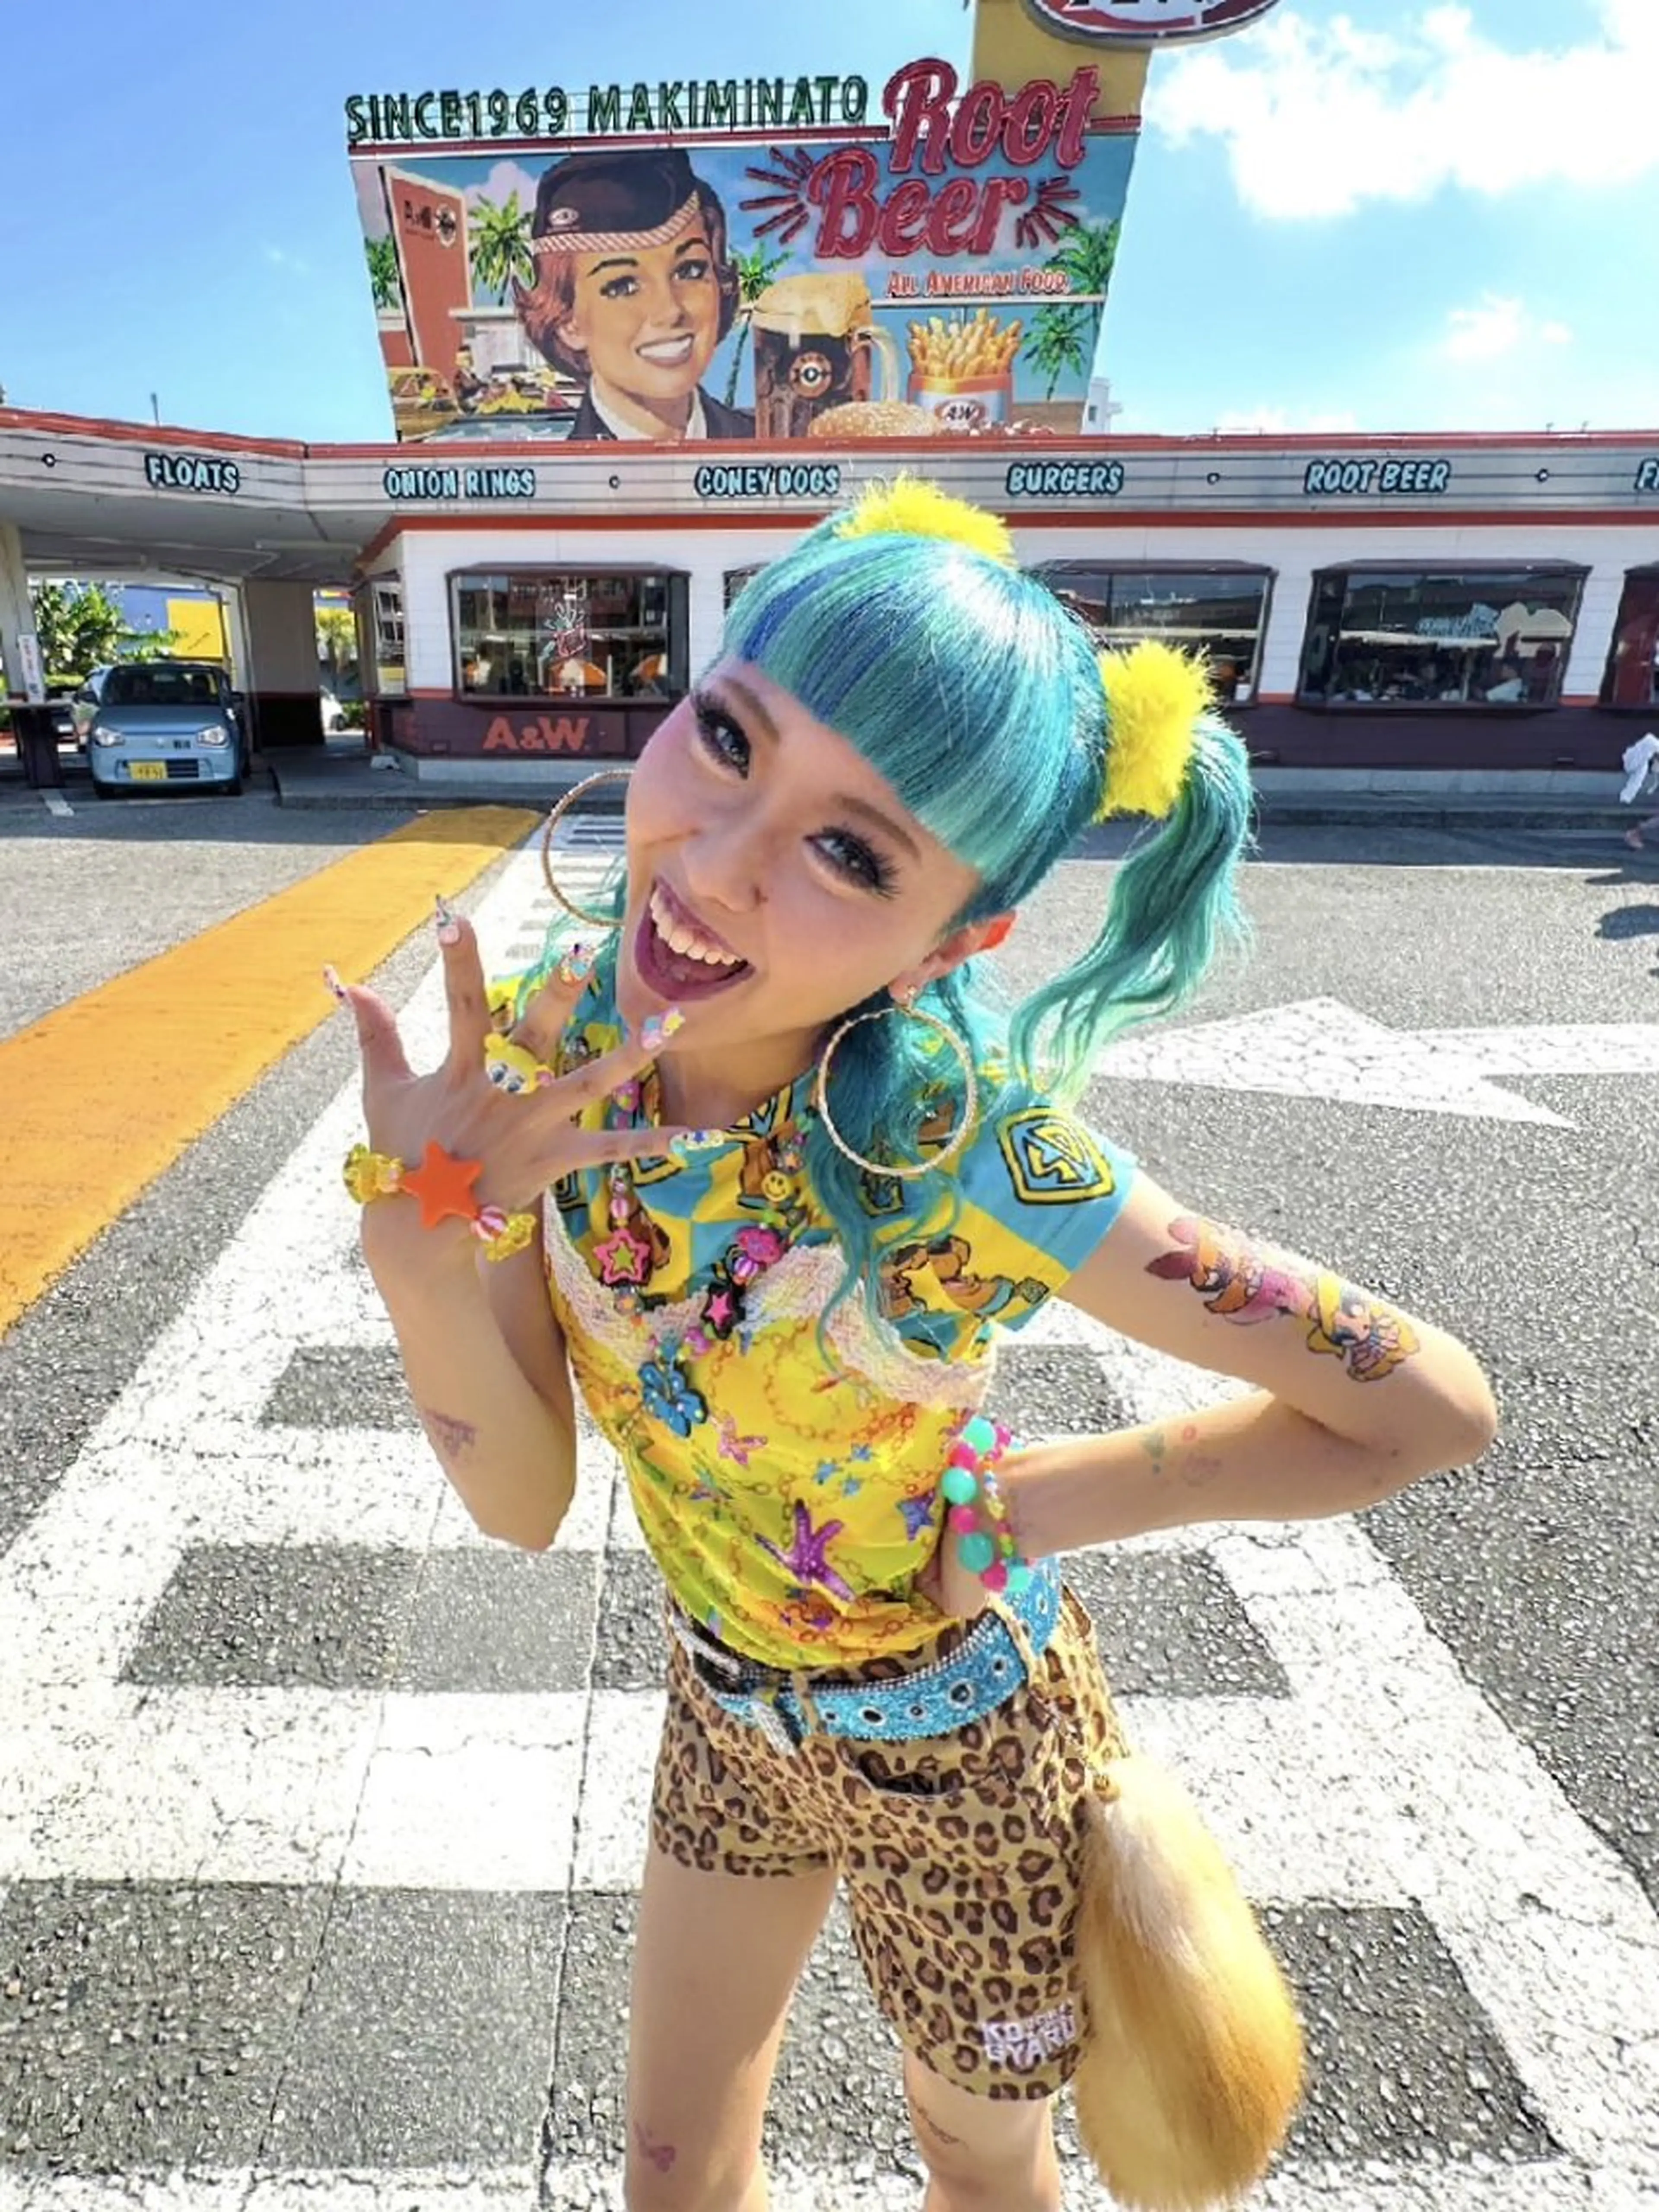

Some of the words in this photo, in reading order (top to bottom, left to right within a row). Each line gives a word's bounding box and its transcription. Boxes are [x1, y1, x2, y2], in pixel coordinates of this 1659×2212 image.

[588, 75, 868, 133] MAKIMINATO
[883, 57, 1101, 174] Root
[807, 147, 1029, 258] Beer
[146, 454, 239, 493] FLOATS
[384, 468, 458, 498] ONION
[464, 468, 535, 497] RINGS
[695, 466, 774, 496] CONEY
[776, 465, 840, 496] DOGS
[1006, 462, 1124, 495] BURGERS
[1305, 460, 1377, 494] ROOT
[1379, 460, 1449, 493] BEER
[482, 716, 590, 750] A&W
